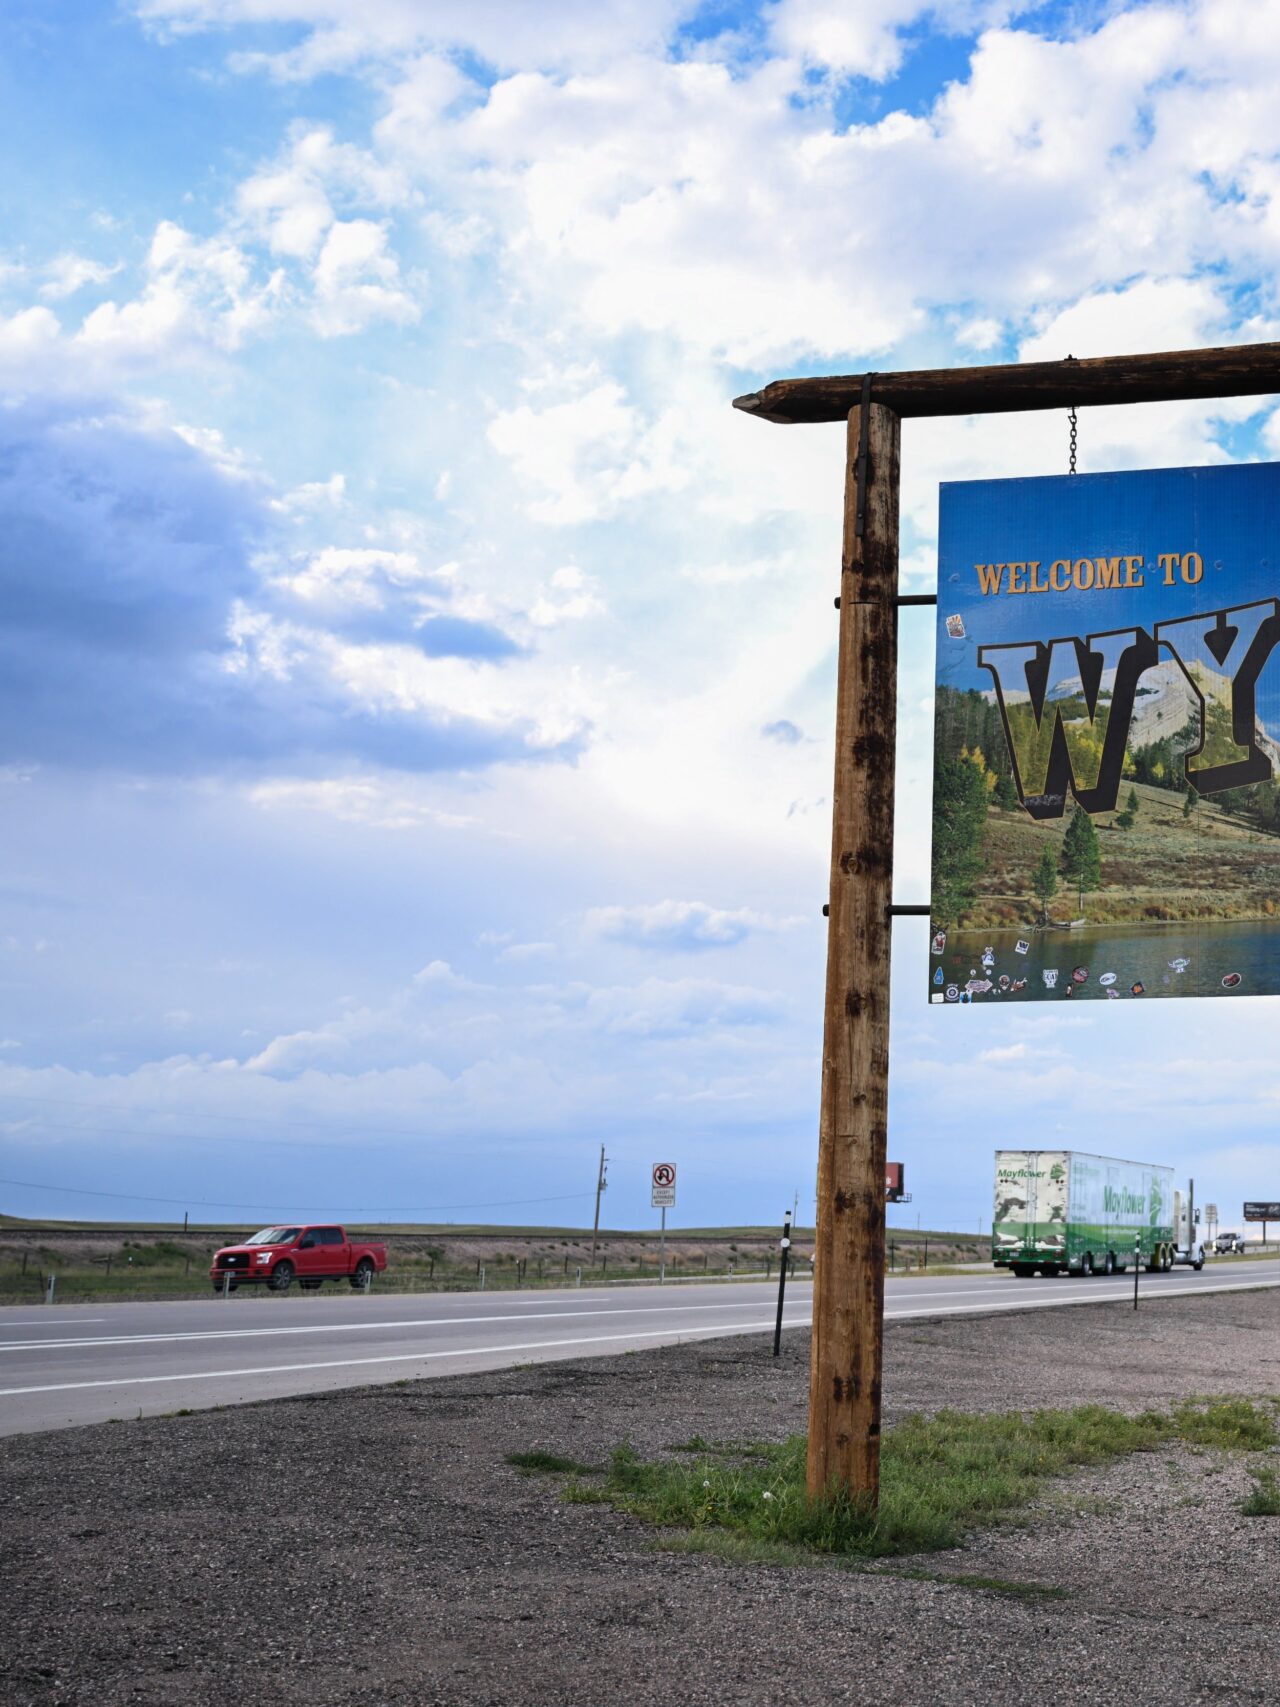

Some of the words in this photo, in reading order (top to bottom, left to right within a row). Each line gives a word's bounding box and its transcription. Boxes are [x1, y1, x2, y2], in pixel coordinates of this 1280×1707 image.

[975, 555, 1145, 595] WELCOME
[1157, 551, 1204, 587] TO
[997, 1168, 1046, 1179] Mayflower
[1104, 1185, 1146, 1215] Mayflower
